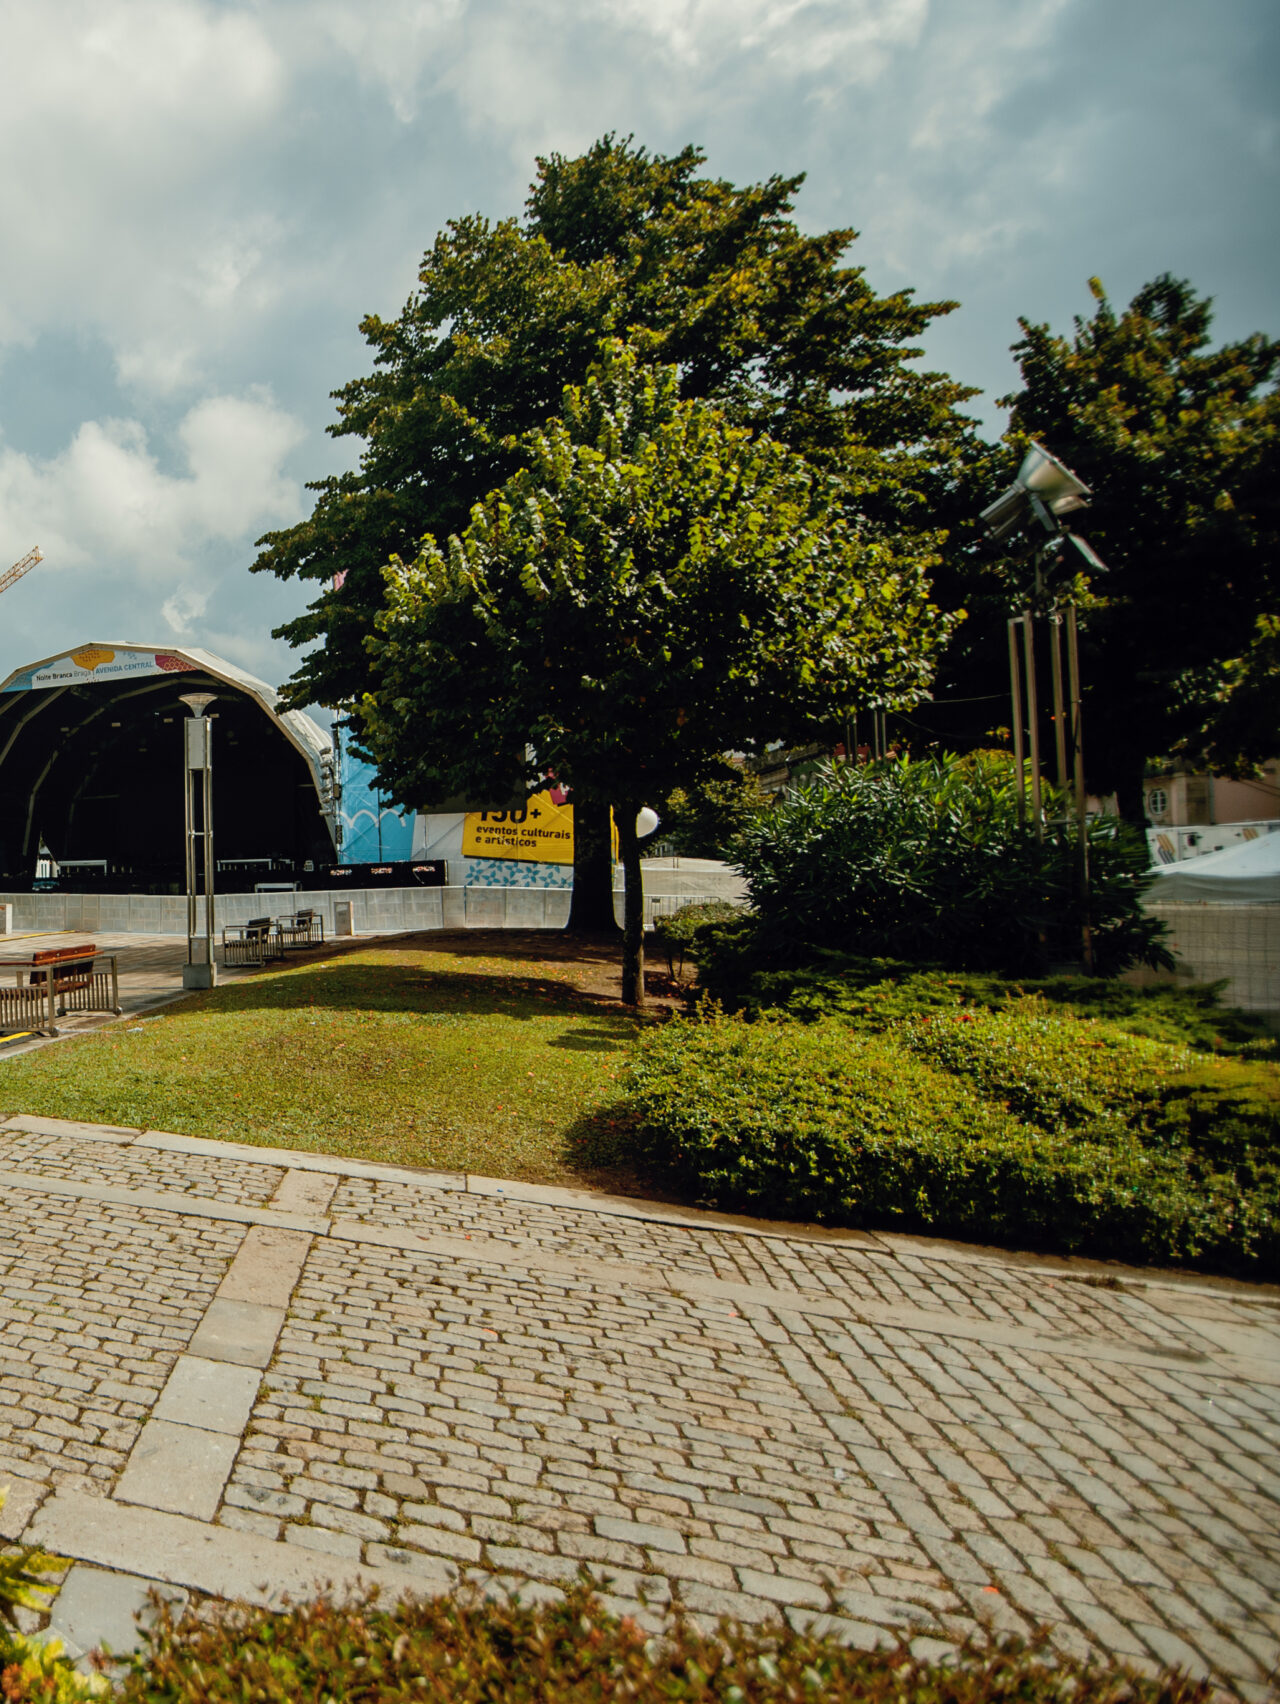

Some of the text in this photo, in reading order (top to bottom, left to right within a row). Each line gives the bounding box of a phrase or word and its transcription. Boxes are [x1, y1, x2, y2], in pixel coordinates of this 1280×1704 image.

[36, 661, 153, 682] Noite Branca Braga AVENIDA CENTRAL
[476, 826, 571, 839] eventos culturais
[485, 835, 537, 847] artísticos
